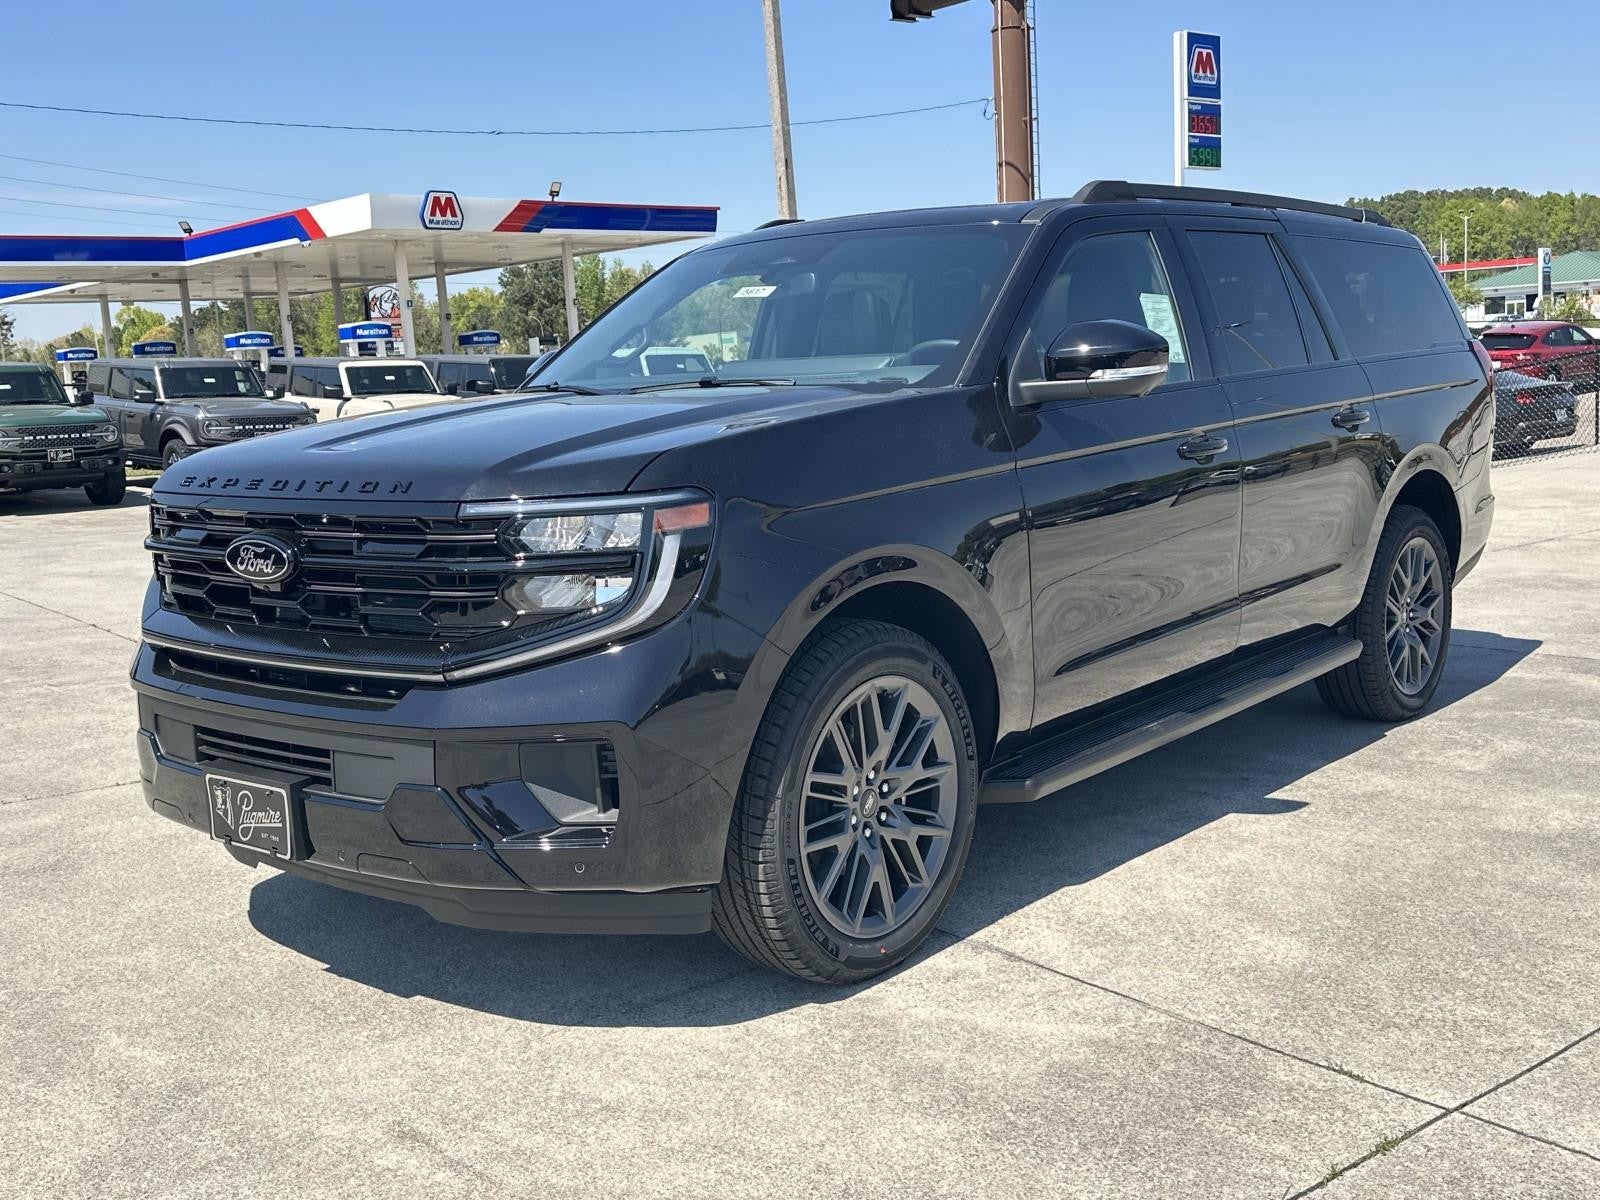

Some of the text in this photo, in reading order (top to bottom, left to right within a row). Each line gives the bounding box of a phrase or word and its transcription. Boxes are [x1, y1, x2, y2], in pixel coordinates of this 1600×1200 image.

[430, 195, 458, 218] M
[428, 218, 460, 226] Marathon
[356, 327, 389, 336] Marathon
[67, 351, 95, 359] Marathon
[178, 475, 416, 495] EXPEDITION
[235, 544, 276, 575] Ford
[944, 681, 976, 758] MICHELIN
[237, 789, 283, 841] Pugmire
[787, 862, 829, 947] MICHELIN
